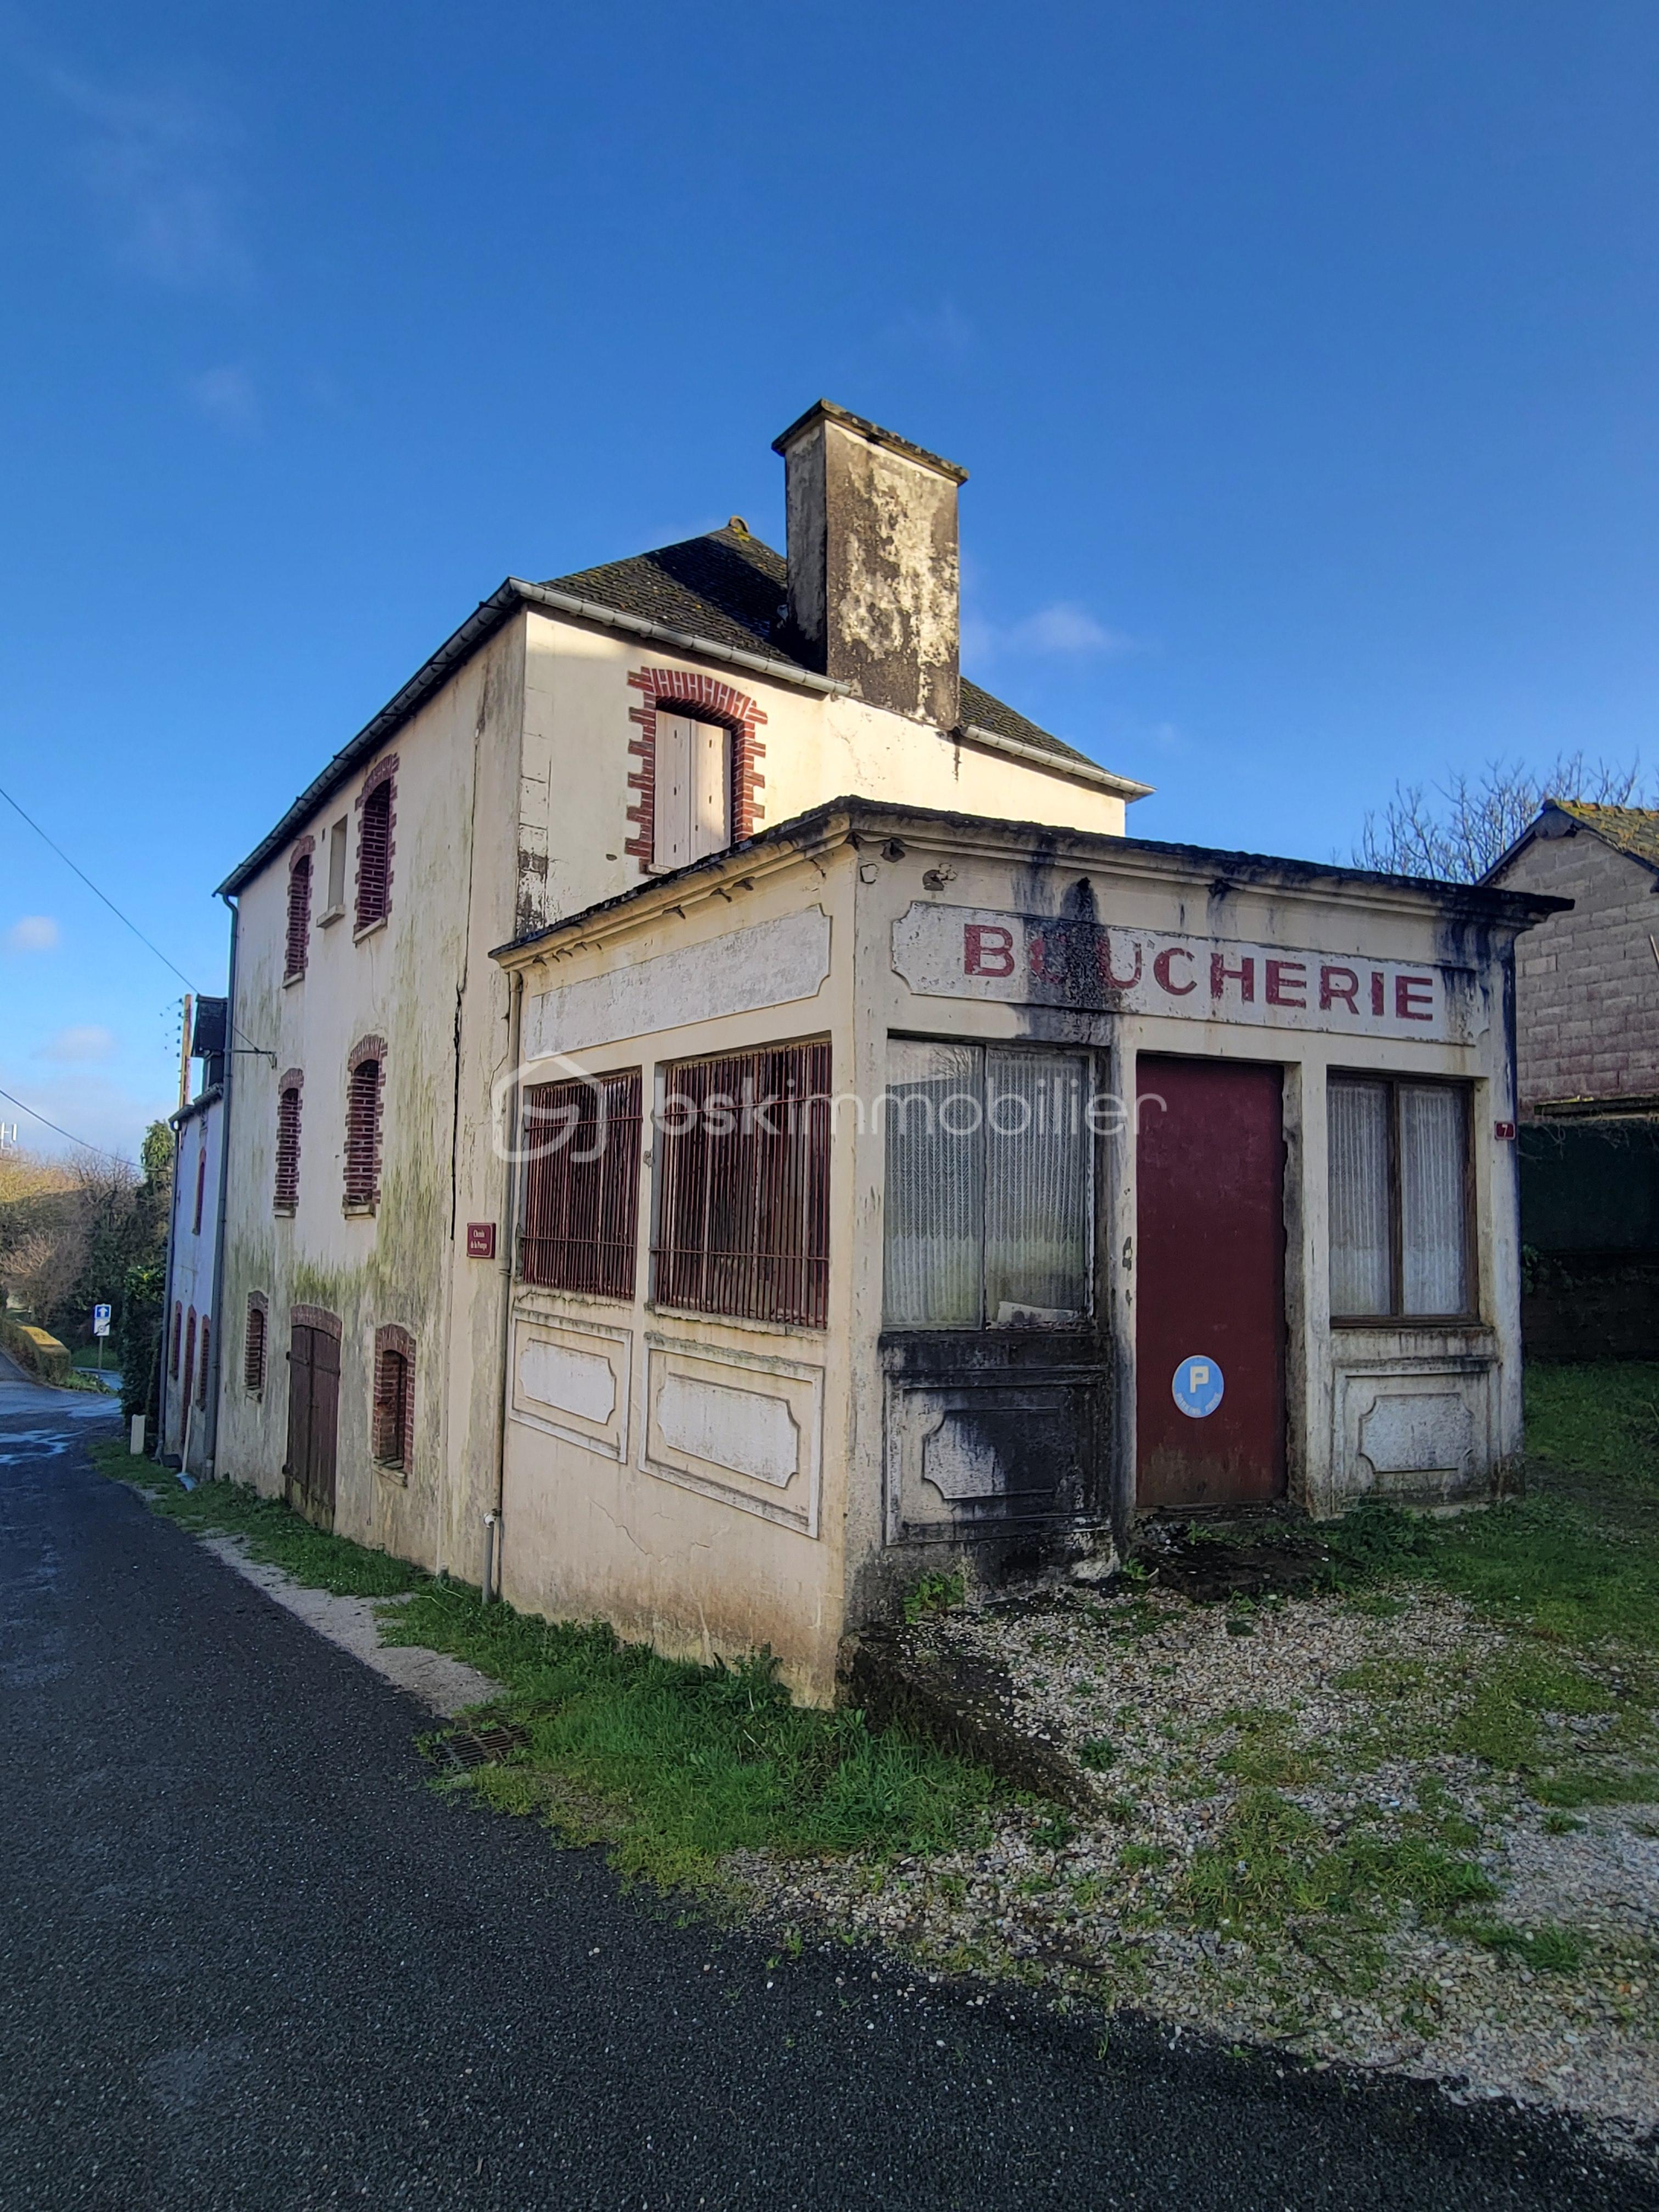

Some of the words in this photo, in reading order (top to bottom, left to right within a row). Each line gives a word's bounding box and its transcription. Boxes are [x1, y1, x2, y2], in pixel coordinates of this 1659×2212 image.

[964, 923, 1433, 1022] BOUCHERIE
[1502, 1124, 1508, 1137] 7
[1190, 1366, 1209, 1393] P
[1176, 1392, 1201, 1415] PARKING
